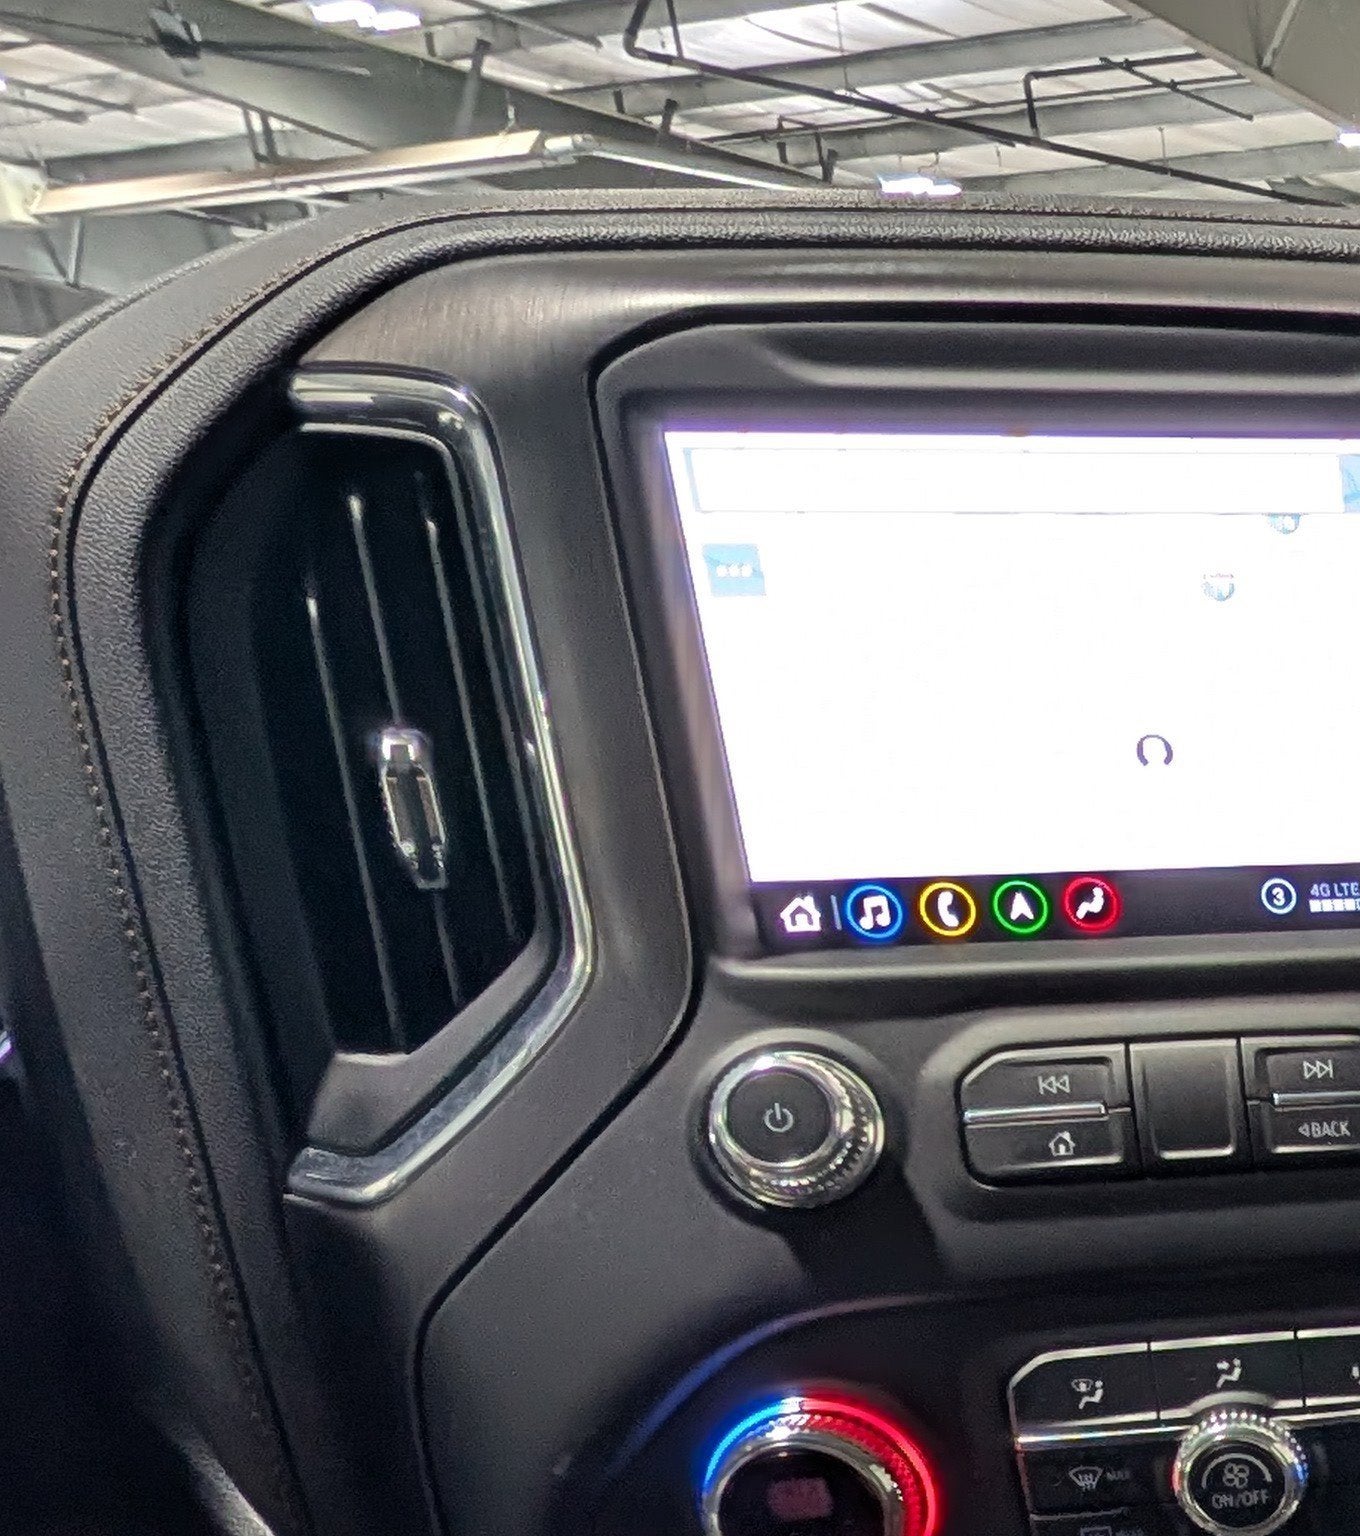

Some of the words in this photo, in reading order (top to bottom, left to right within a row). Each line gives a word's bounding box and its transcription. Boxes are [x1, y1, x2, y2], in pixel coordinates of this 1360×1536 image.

[1272, 887, 1285, 906] 3
[1310, 883, 1331, 897] 4G
[1333, 882, 1360, 897] LTE
[1311, 1120, 1351, 1138] BACK
